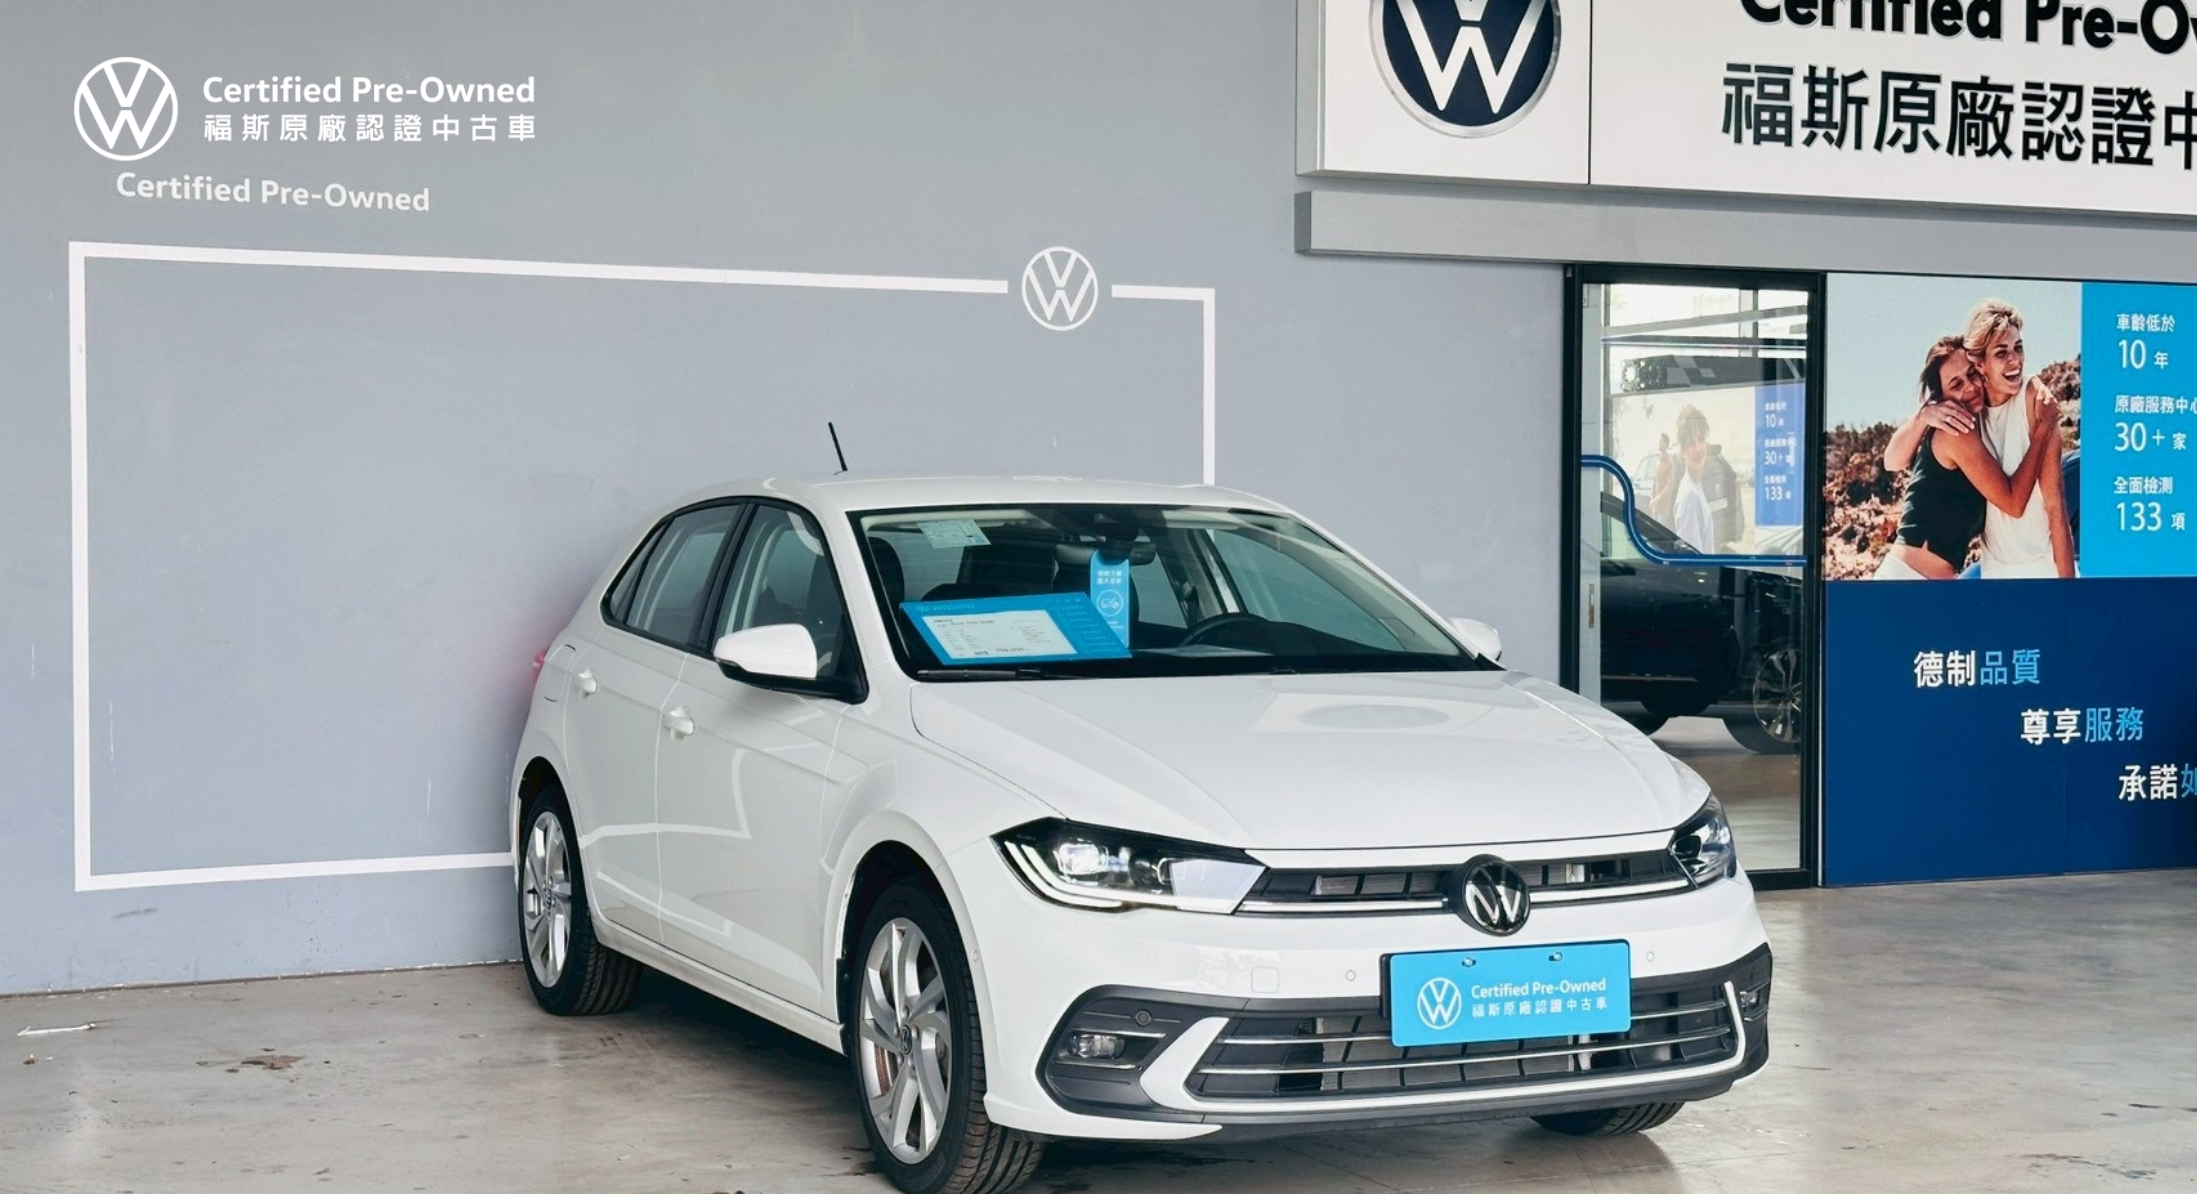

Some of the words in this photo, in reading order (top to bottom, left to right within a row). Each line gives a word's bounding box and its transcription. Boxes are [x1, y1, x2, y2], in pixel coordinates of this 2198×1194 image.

[2025, 0, 2197, 55] Pre-O
[1722, 63, 2197, 170] 福斯原廠認證中
[116, 172, 251, 203] Certified
[261, 180, 430, 212] Pre-Owned
[2116, 313, 2176, 332] 車齡低於
[2118, 339, 2147, 369] 10
[2154, 351, 2169, 369] 年
[2172, 432, 2187, 451] 家
[2114, 476, 2173, 494] 全面檢測
[2116, 501, 2162, 531] 133
[2171, 513, 2186, 531] 項
[1912, 648, 2041, 689] 德制品質
[2020, 706, 2145, 746] 尊享服務
[1470, 982, 1530, 999] Certified
[1532, 977, 1607, 995] Pre-Owned
[1472, 998, 1608, 1018] 福斯原廠認證中古車
